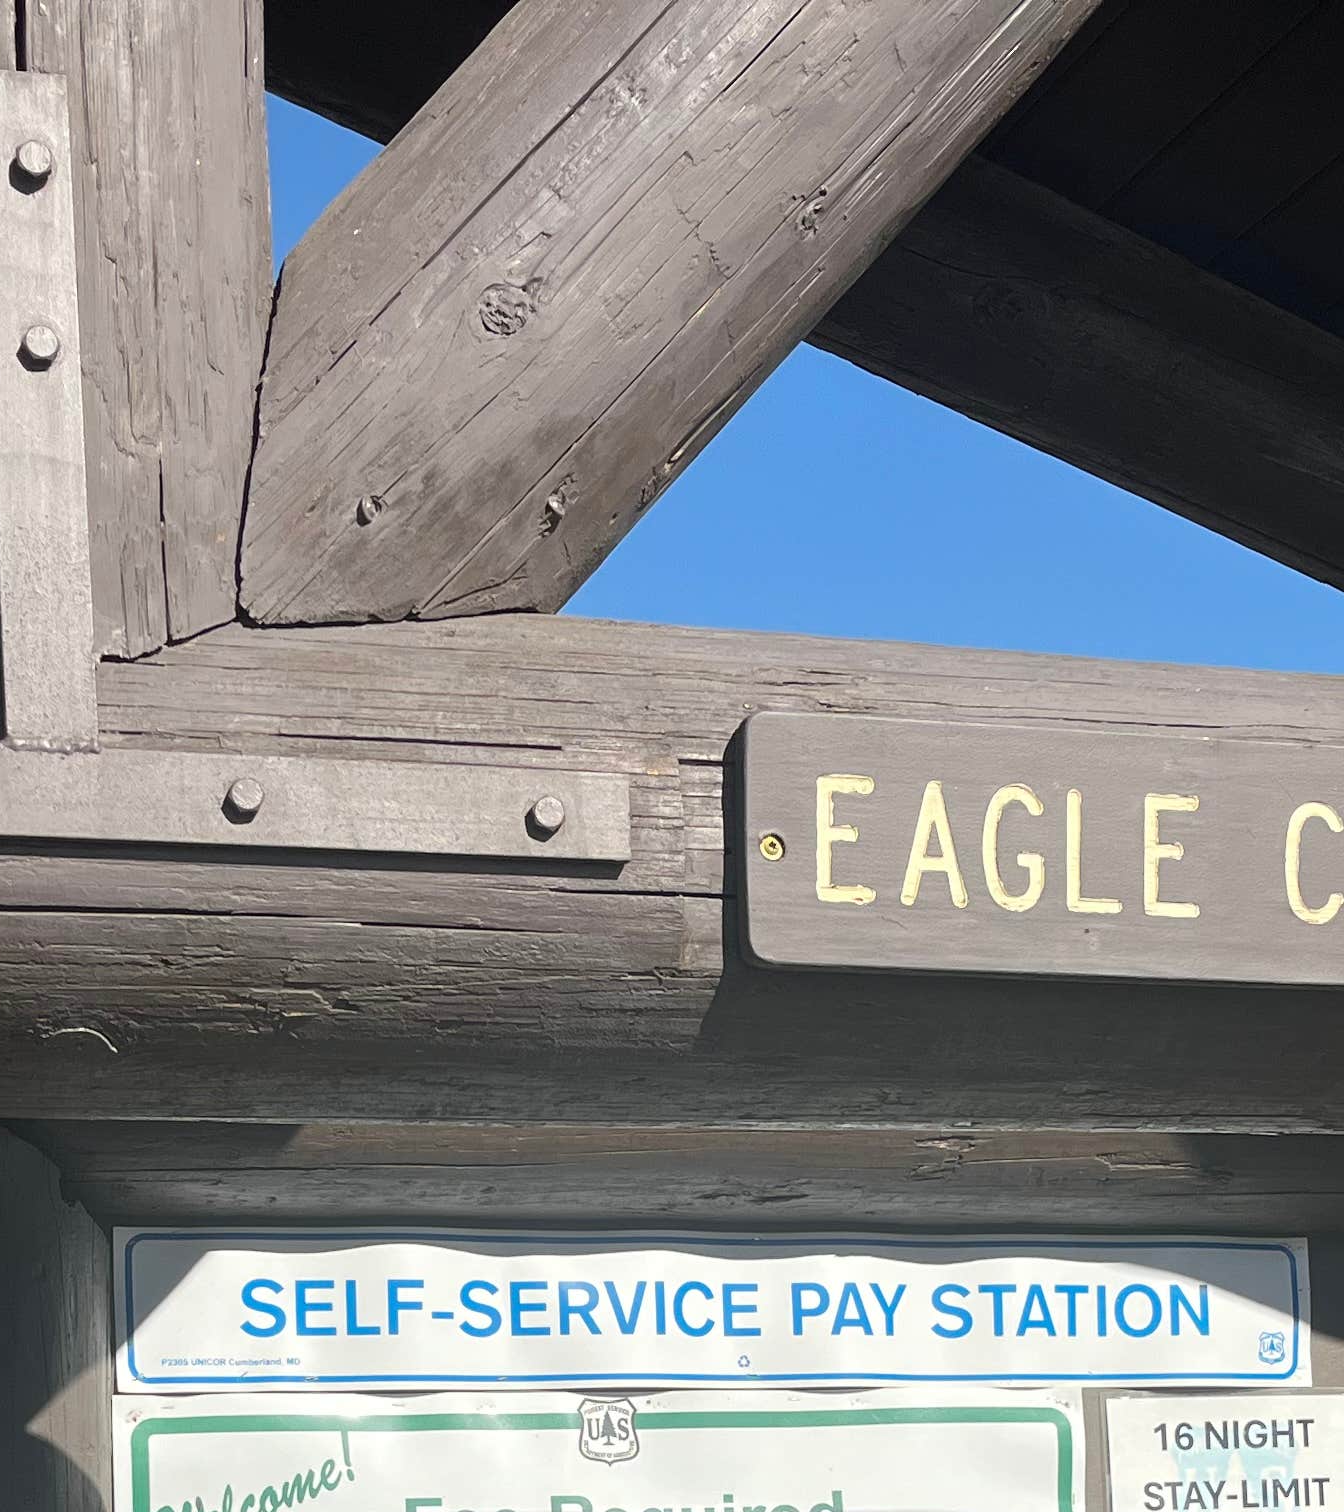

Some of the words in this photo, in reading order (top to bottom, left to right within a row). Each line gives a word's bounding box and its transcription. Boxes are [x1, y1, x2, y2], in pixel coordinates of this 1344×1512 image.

[813, 773, 1201, 919] EAGLE
[240, 1279, 761, 1337] SELF-SERVICE
[792, 1282, 906, 1336] PAY
[931, 1283, 1209, 1337] STATION
[1153, 1423, 1194, 1450] 16
[1205, 1420, 1314, 1449] NIGHT
[1144, 1479, 1330, 1511] STAY-LIMIT
